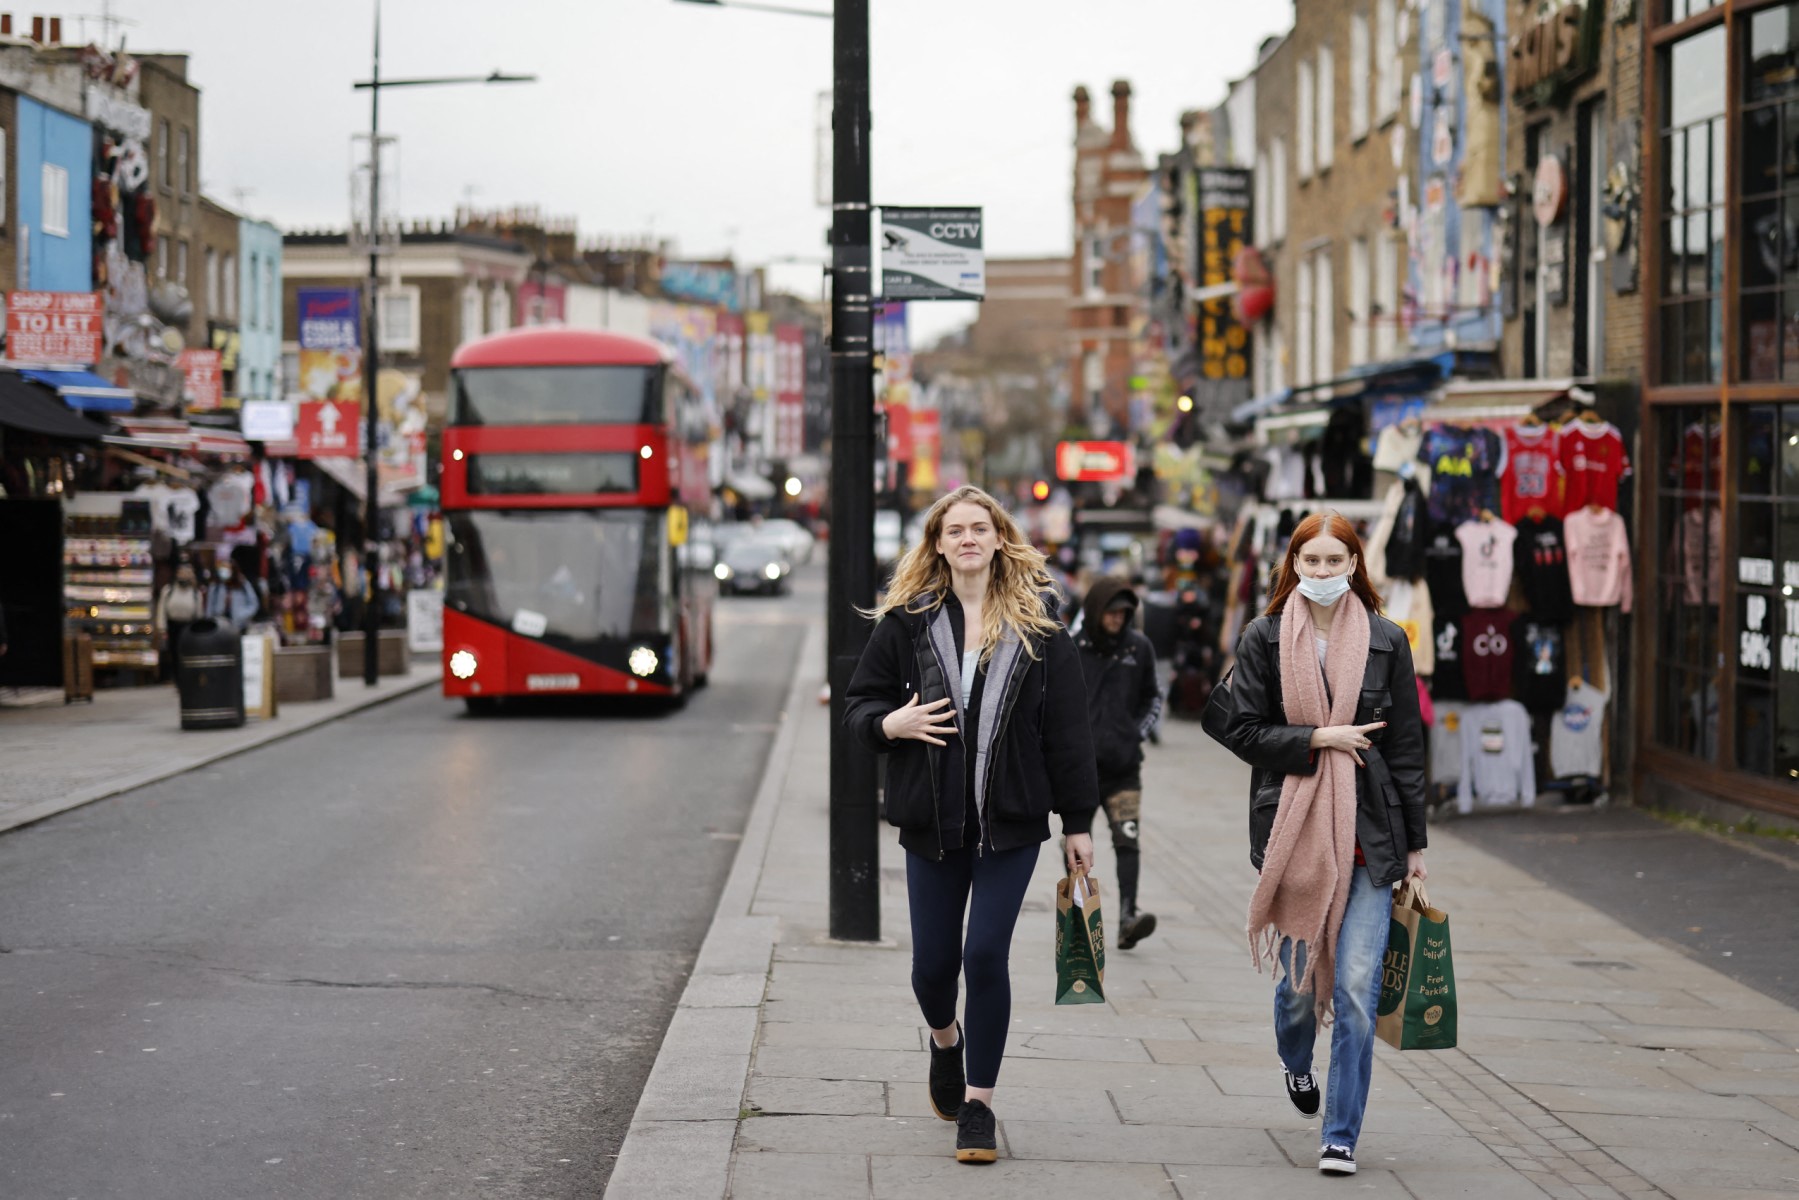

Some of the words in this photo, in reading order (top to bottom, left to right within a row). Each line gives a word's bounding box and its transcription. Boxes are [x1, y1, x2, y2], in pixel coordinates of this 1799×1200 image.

[930, 222, 980, 239] CCTV
[12, 292, 52, 309] SHOP
[17, 312, 49, 334] TO
[52, 313, 92, 334] LET
[1436, 455, 1472, 477] AIA
[1747, 594, 1767, 631] UP
[1741, 631, 1771, 671] 50%
